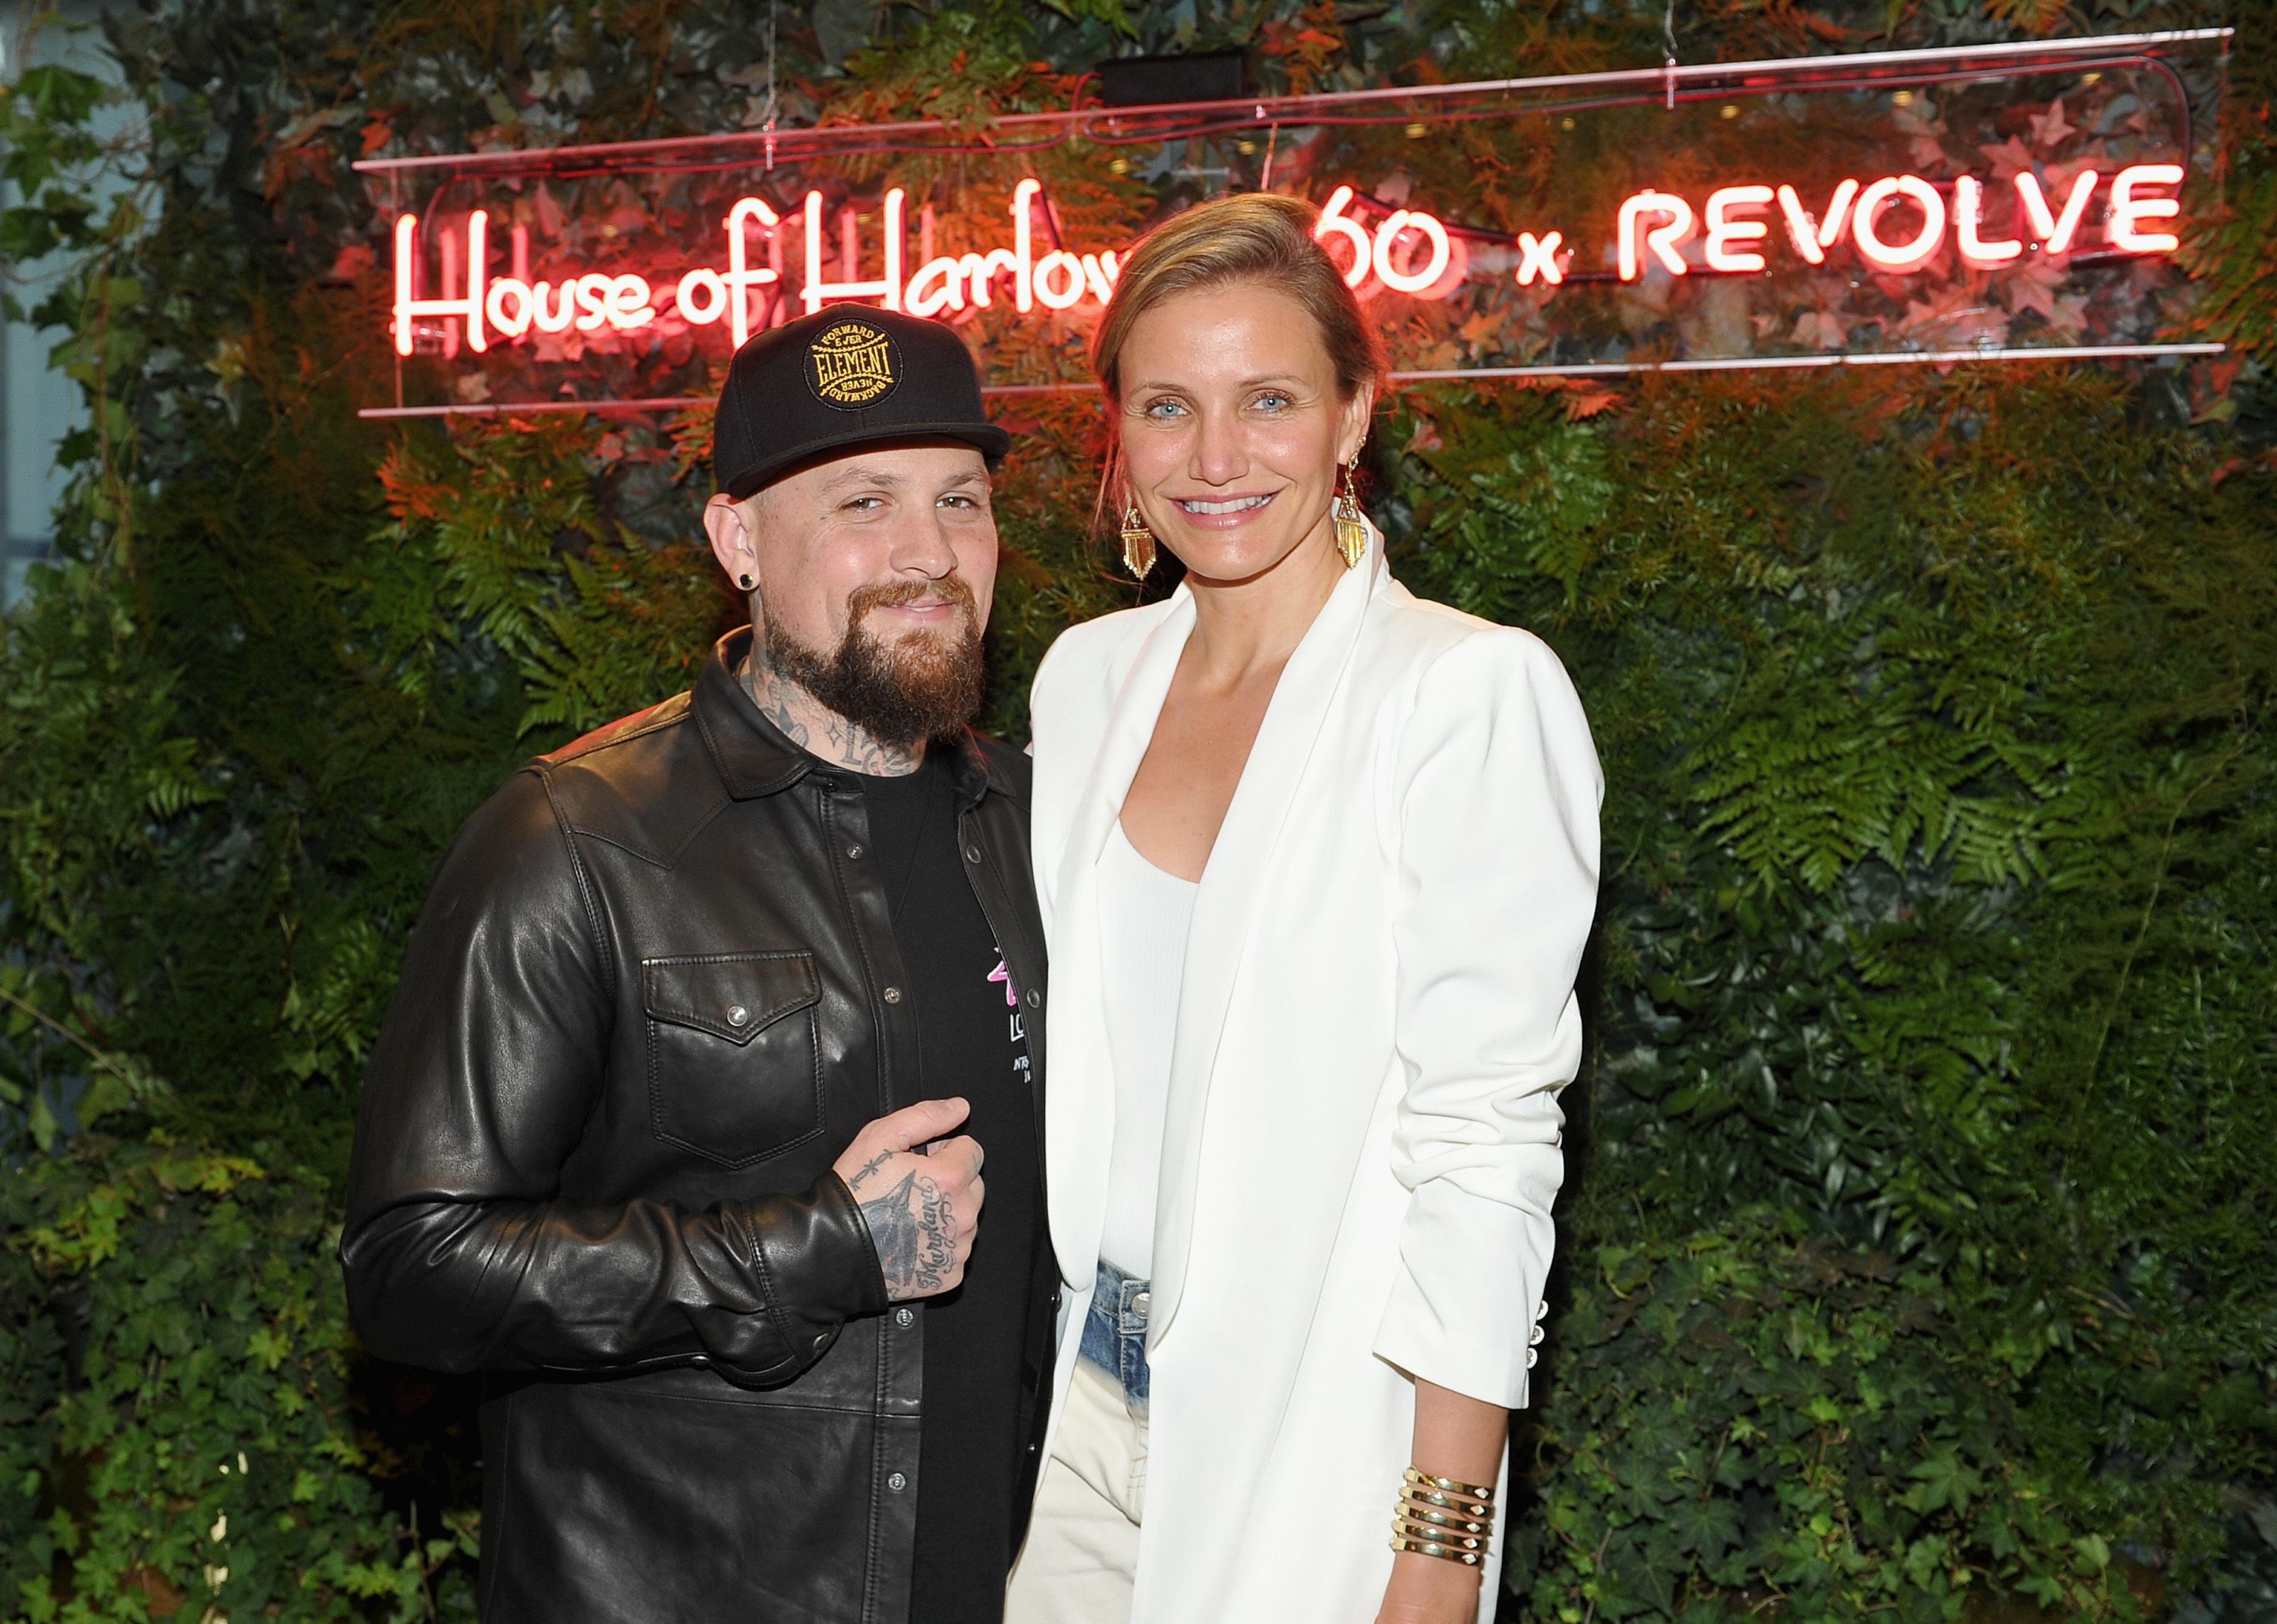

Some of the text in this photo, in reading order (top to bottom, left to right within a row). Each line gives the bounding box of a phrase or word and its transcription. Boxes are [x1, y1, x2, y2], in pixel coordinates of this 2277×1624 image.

[391, 209, 657, 357] House
[676, 197, 779, 349] of
[1517, 229, 1564, 286] x
[1617, 164, 2185, 282] REVOLVE
[820, 324, 874, 345] FORWARD
[835, 335, 862, 347] EVER
[813, 341, 891, 387] ELEMENT
[829, 380, 887, 402] BACKWARD
[842, 378, 874, 391] NEVER
[915, 1176, 956, 1290] Maryland
